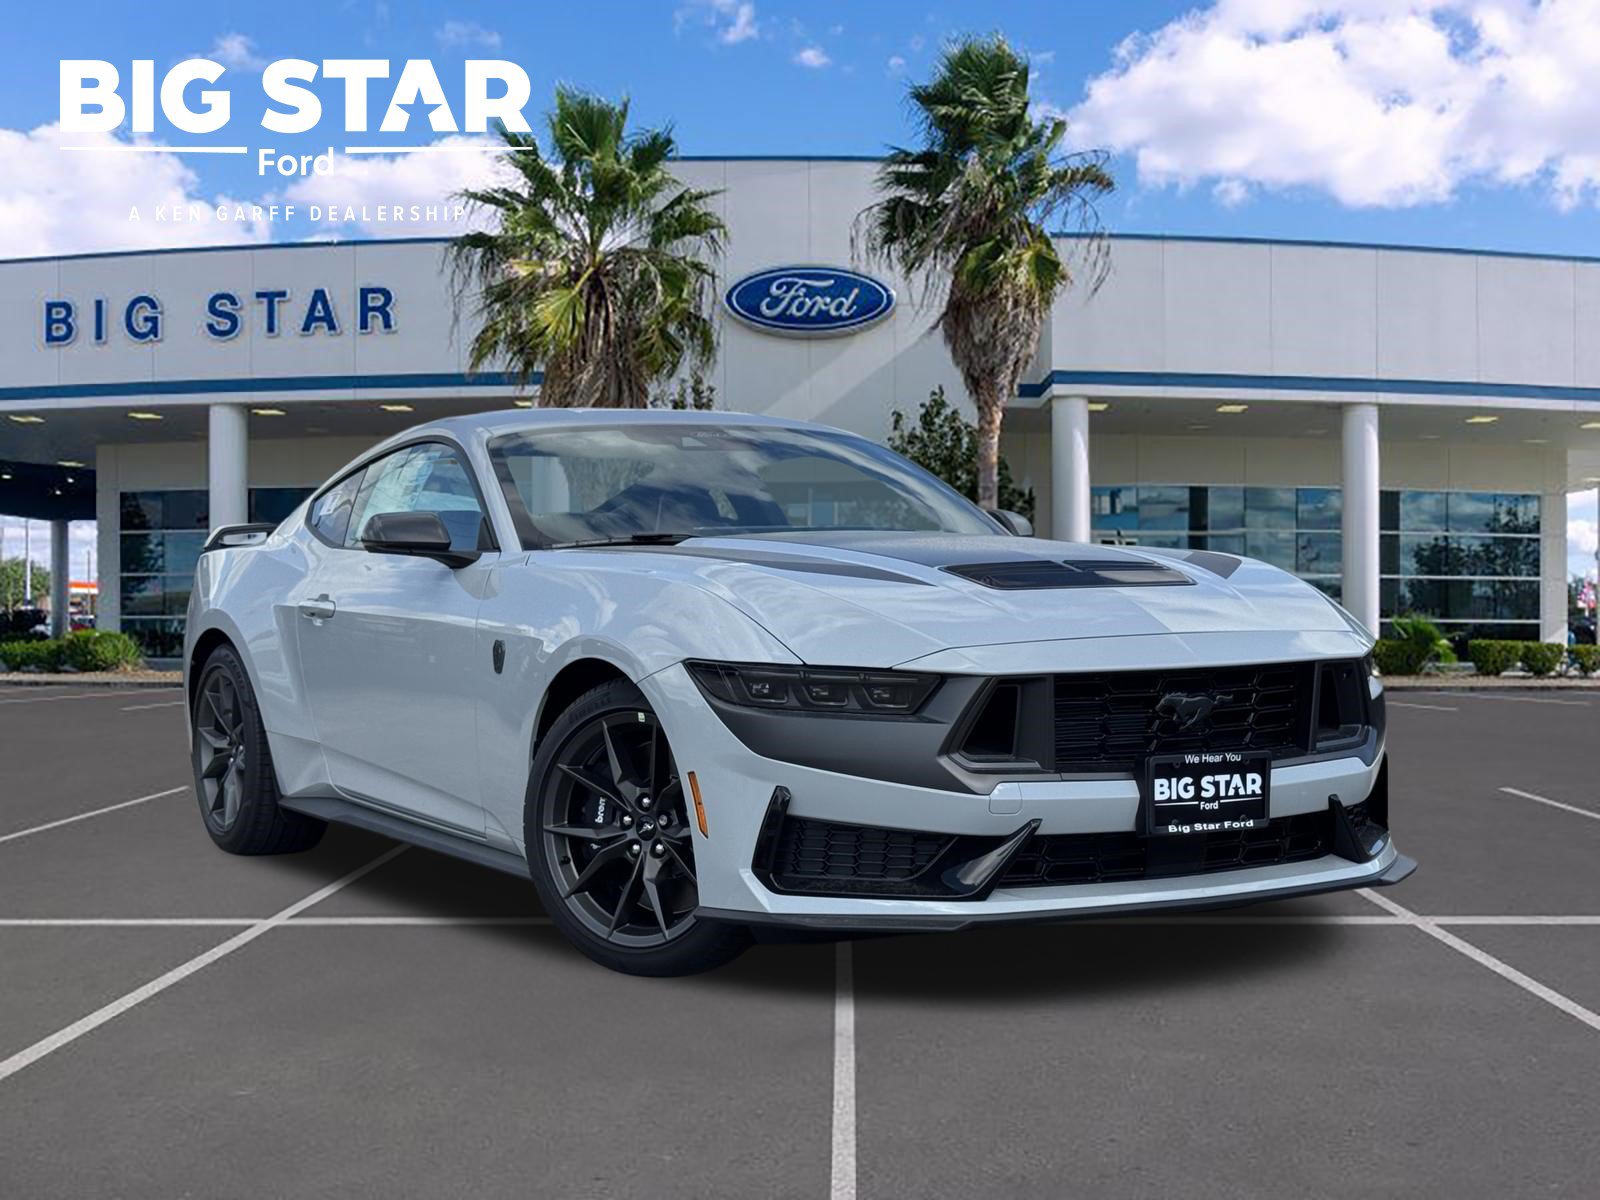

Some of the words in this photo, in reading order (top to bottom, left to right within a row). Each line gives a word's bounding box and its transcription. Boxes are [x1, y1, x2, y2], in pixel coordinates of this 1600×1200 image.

[760, 277, 859, 318] Ford
[44, 294, 164, 345] BIG
[205, 286, 397, 341] STAR
[1184, 753, 1200, 764] We
[1202, 753, 1223, 763] Hear
[1225, 752, 1242, 762] You
[1154, 776, 1195, 801] BIG
[1200, 772, 1262, 798] STAR
[1200, 800, 1219, 811] Ford
[1168, 823, 1191, 834] Big
[1194, 821, 1221, 832] Star
[1224, 819, 1254, 829] Ford
